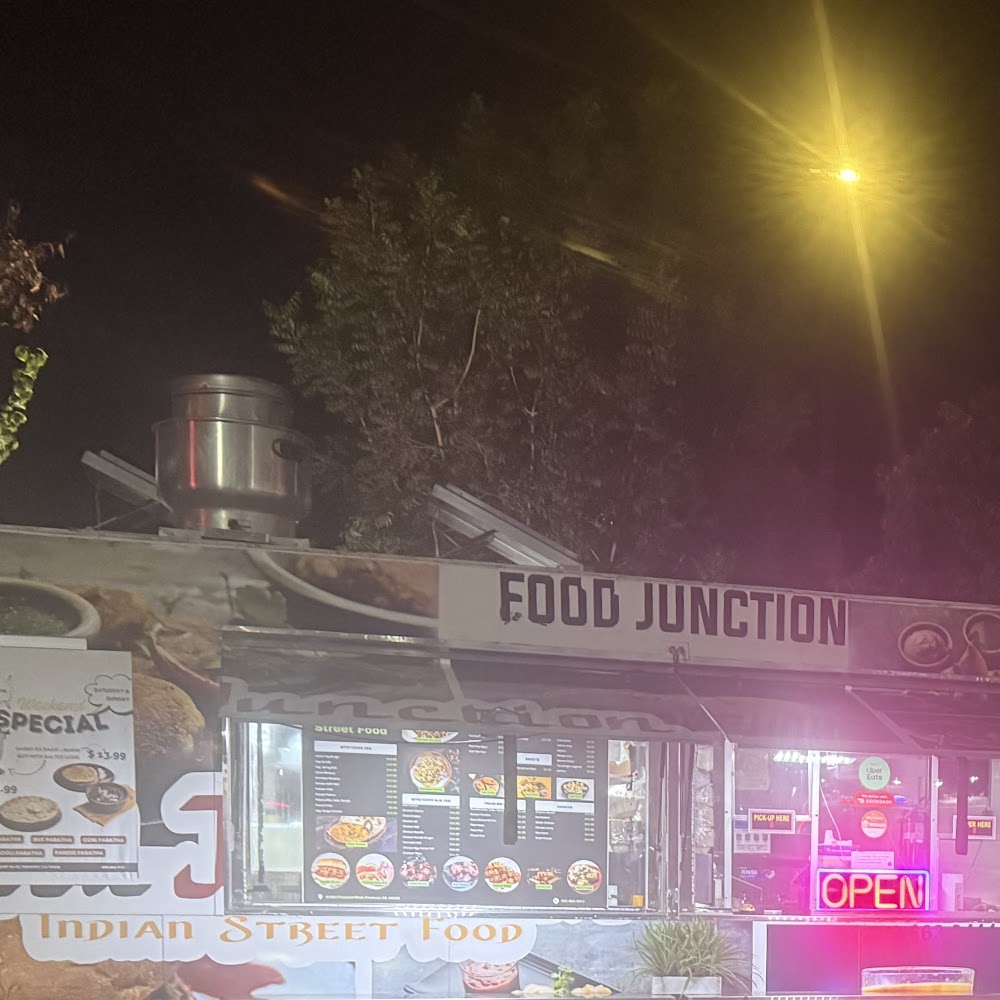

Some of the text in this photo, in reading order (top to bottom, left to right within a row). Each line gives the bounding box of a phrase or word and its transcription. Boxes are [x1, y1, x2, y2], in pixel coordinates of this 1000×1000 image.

[499, 572, 846, 646] FOOD JUNCTION
[0, 709, 110, 735] SPECIAL
[866, 773, 883, 781] Eats
[753, 813, 791, 823] PICK-UP HERE
[821, 873, 924, 910] OPEN
[219, 915, 398, 946] STREET
[421, 917, 523, 943] FOOD
